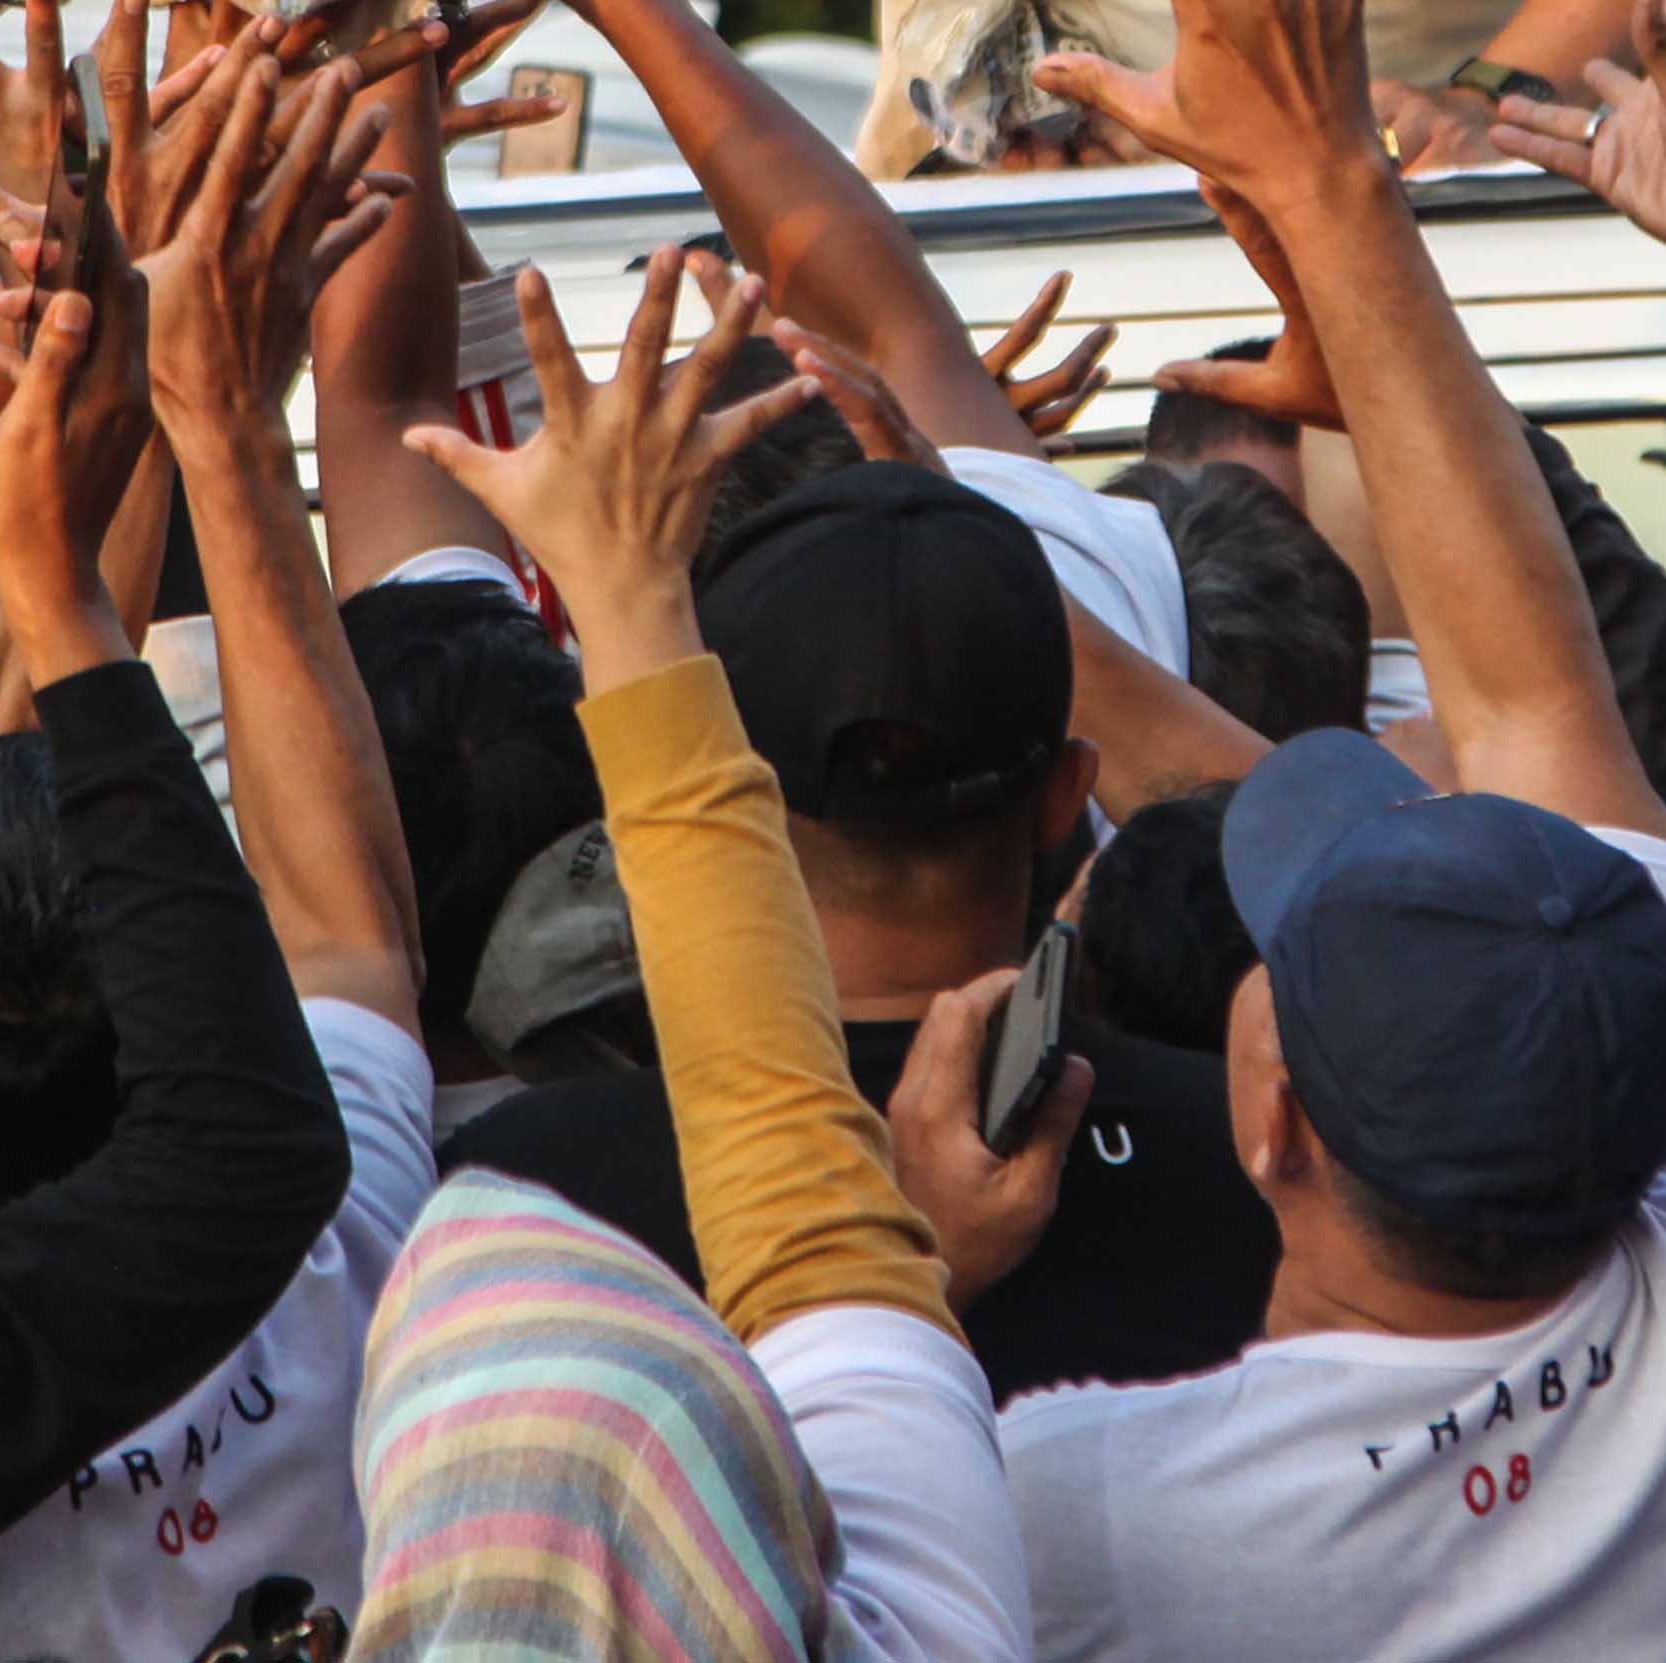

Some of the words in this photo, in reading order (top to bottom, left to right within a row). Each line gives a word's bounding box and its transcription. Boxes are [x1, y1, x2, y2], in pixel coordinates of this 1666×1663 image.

[69, 1372, 275, 1512] PRAU
[1462, 1452, 1532, 1517] 08
[156, 1497, 220, 1557] 08
